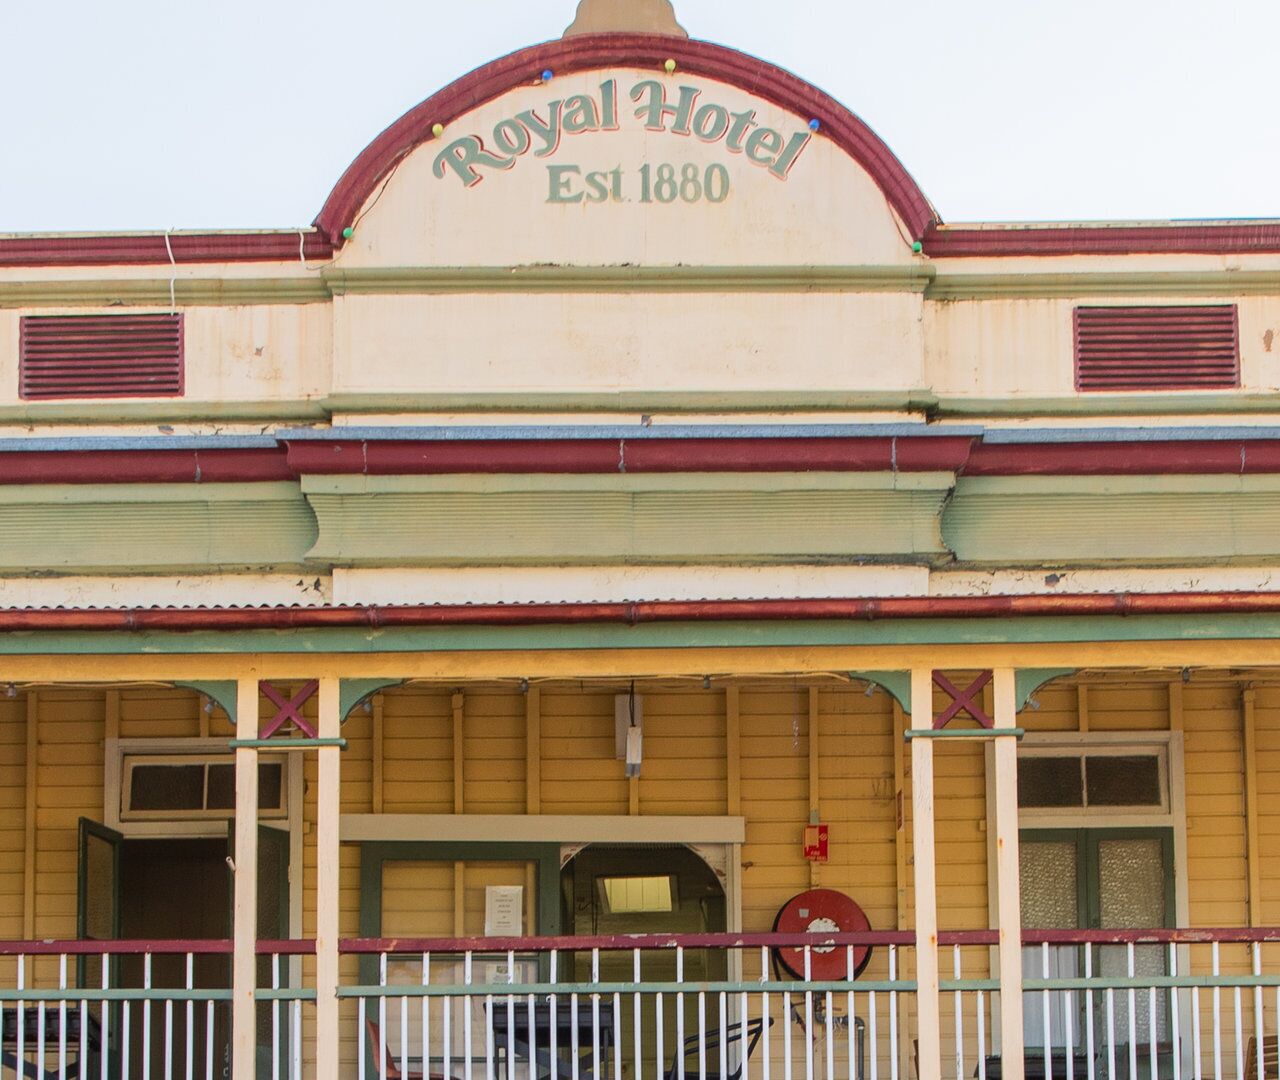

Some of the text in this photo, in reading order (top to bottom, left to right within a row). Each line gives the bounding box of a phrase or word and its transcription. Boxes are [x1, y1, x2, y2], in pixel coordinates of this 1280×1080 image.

[432, 79, 812, 188] Royal Hotel
[639, 163, 730, 203] 1880
